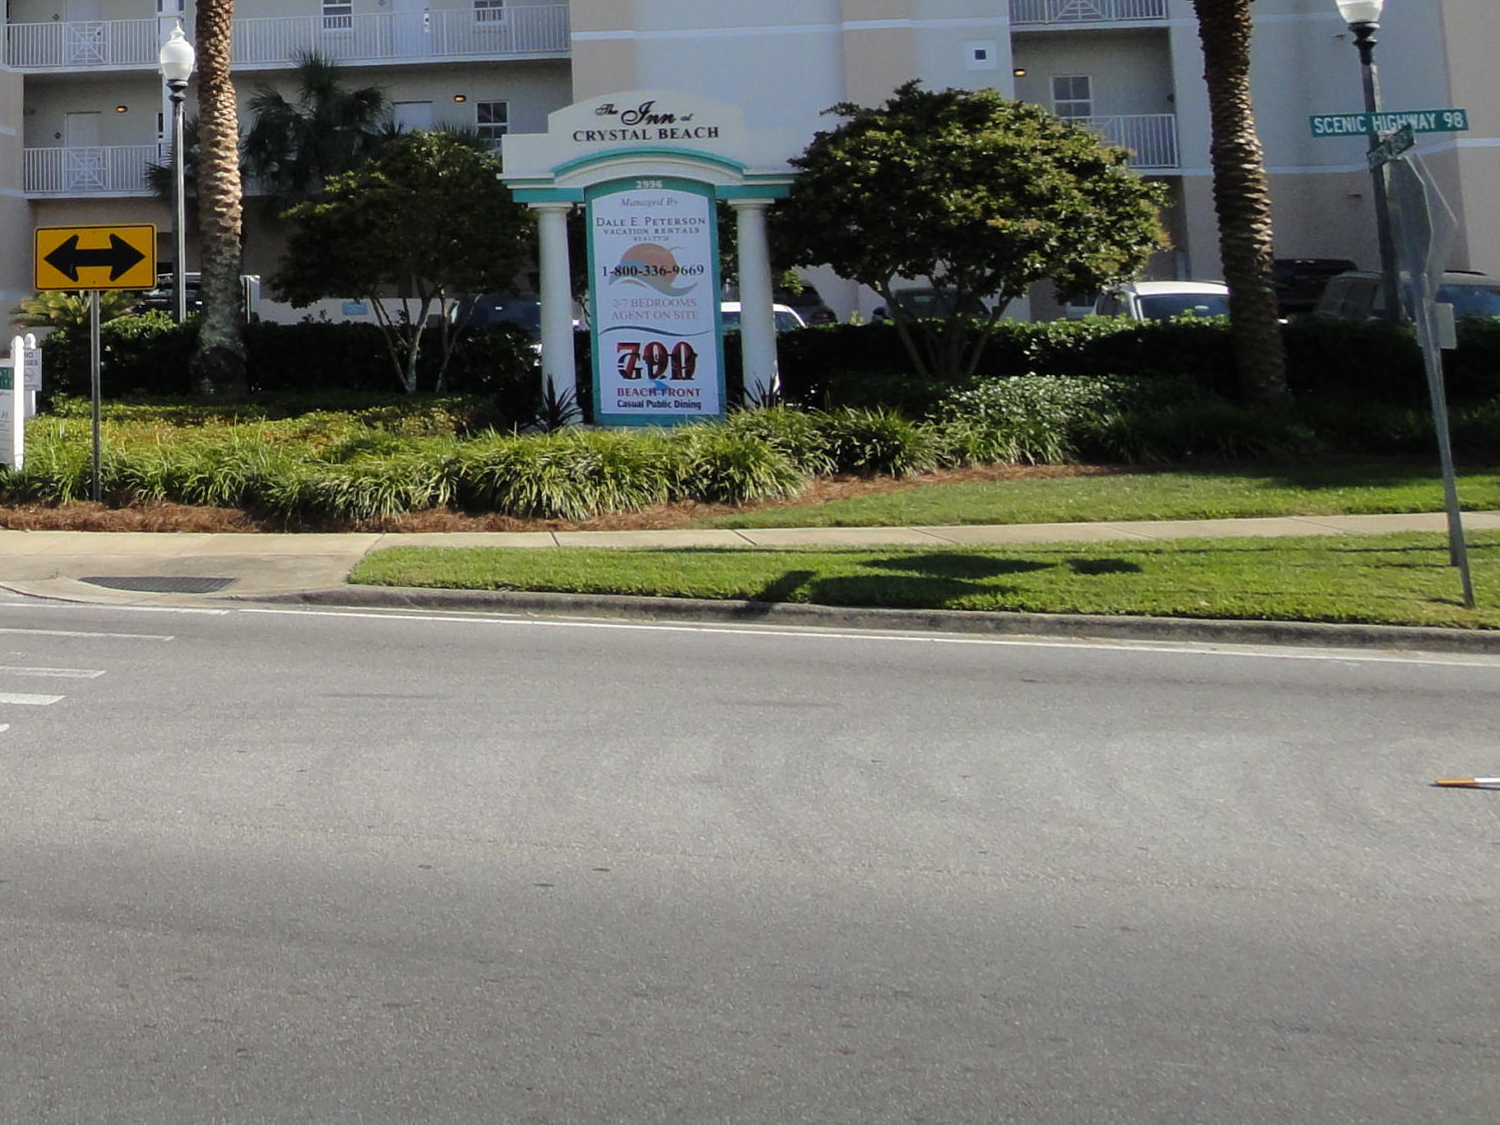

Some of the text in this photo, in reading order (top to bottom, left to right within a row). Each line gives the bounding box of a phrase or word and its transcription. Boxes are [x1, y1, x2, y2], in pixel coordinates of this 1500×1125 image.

[595, 100, 694, 126] The Inn at
[1313, 111, 1464, 134] SCENIC HIGHWAY 98
[572, 126, 719, 142] CRYSTAL BEACH
[621, 196, 663, 208] Managed
[596, 217, 626, 227] DALE
[645, 216, 706, 226] PETERSON
[603, 227, 649, 235] VACATION
[602, 264, 704, 277] 1-800-336-9669
[631, 298, 697, 308] BEDROOMS
[612, 310, 698, 320] AGENT ON SITE
[617, 388, 701, 397] BEACH FRONT
[617, 399, 702, 410] Casual Public Dining
